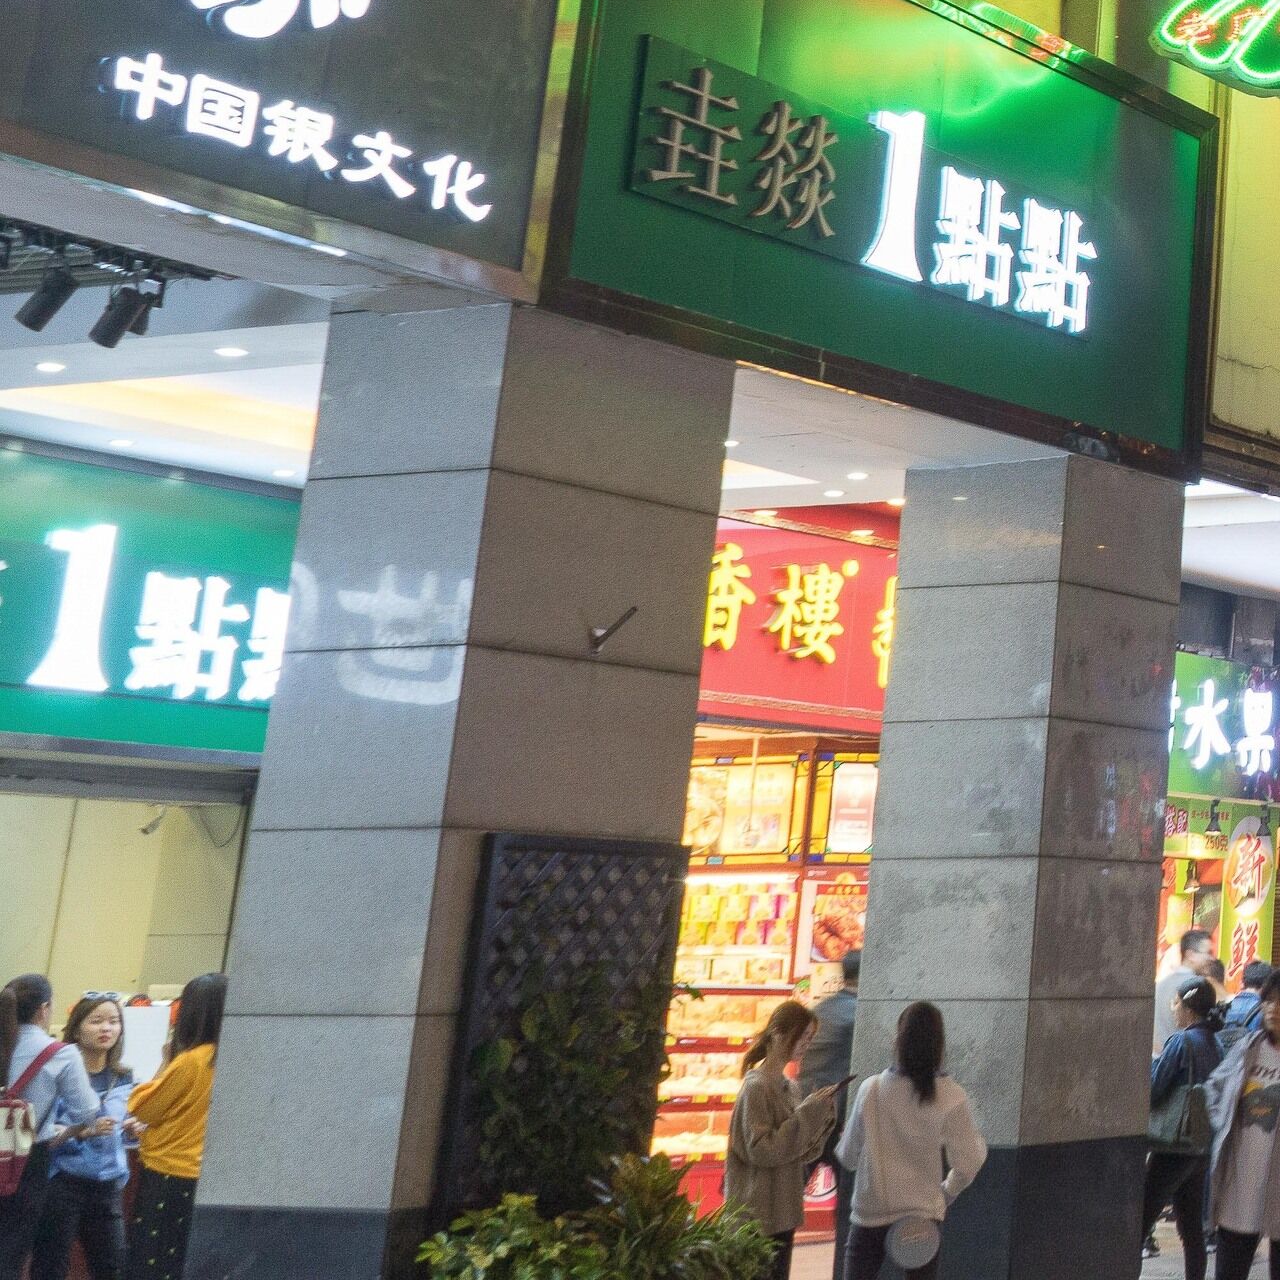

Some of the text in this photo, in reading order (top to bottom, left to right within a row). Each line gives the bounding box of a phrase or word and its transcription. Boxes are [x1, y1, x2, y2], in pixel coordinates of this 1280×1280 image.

[113, 52, 494, 224] 中国银文化
[1168, 677, 1276, 777] 水果
